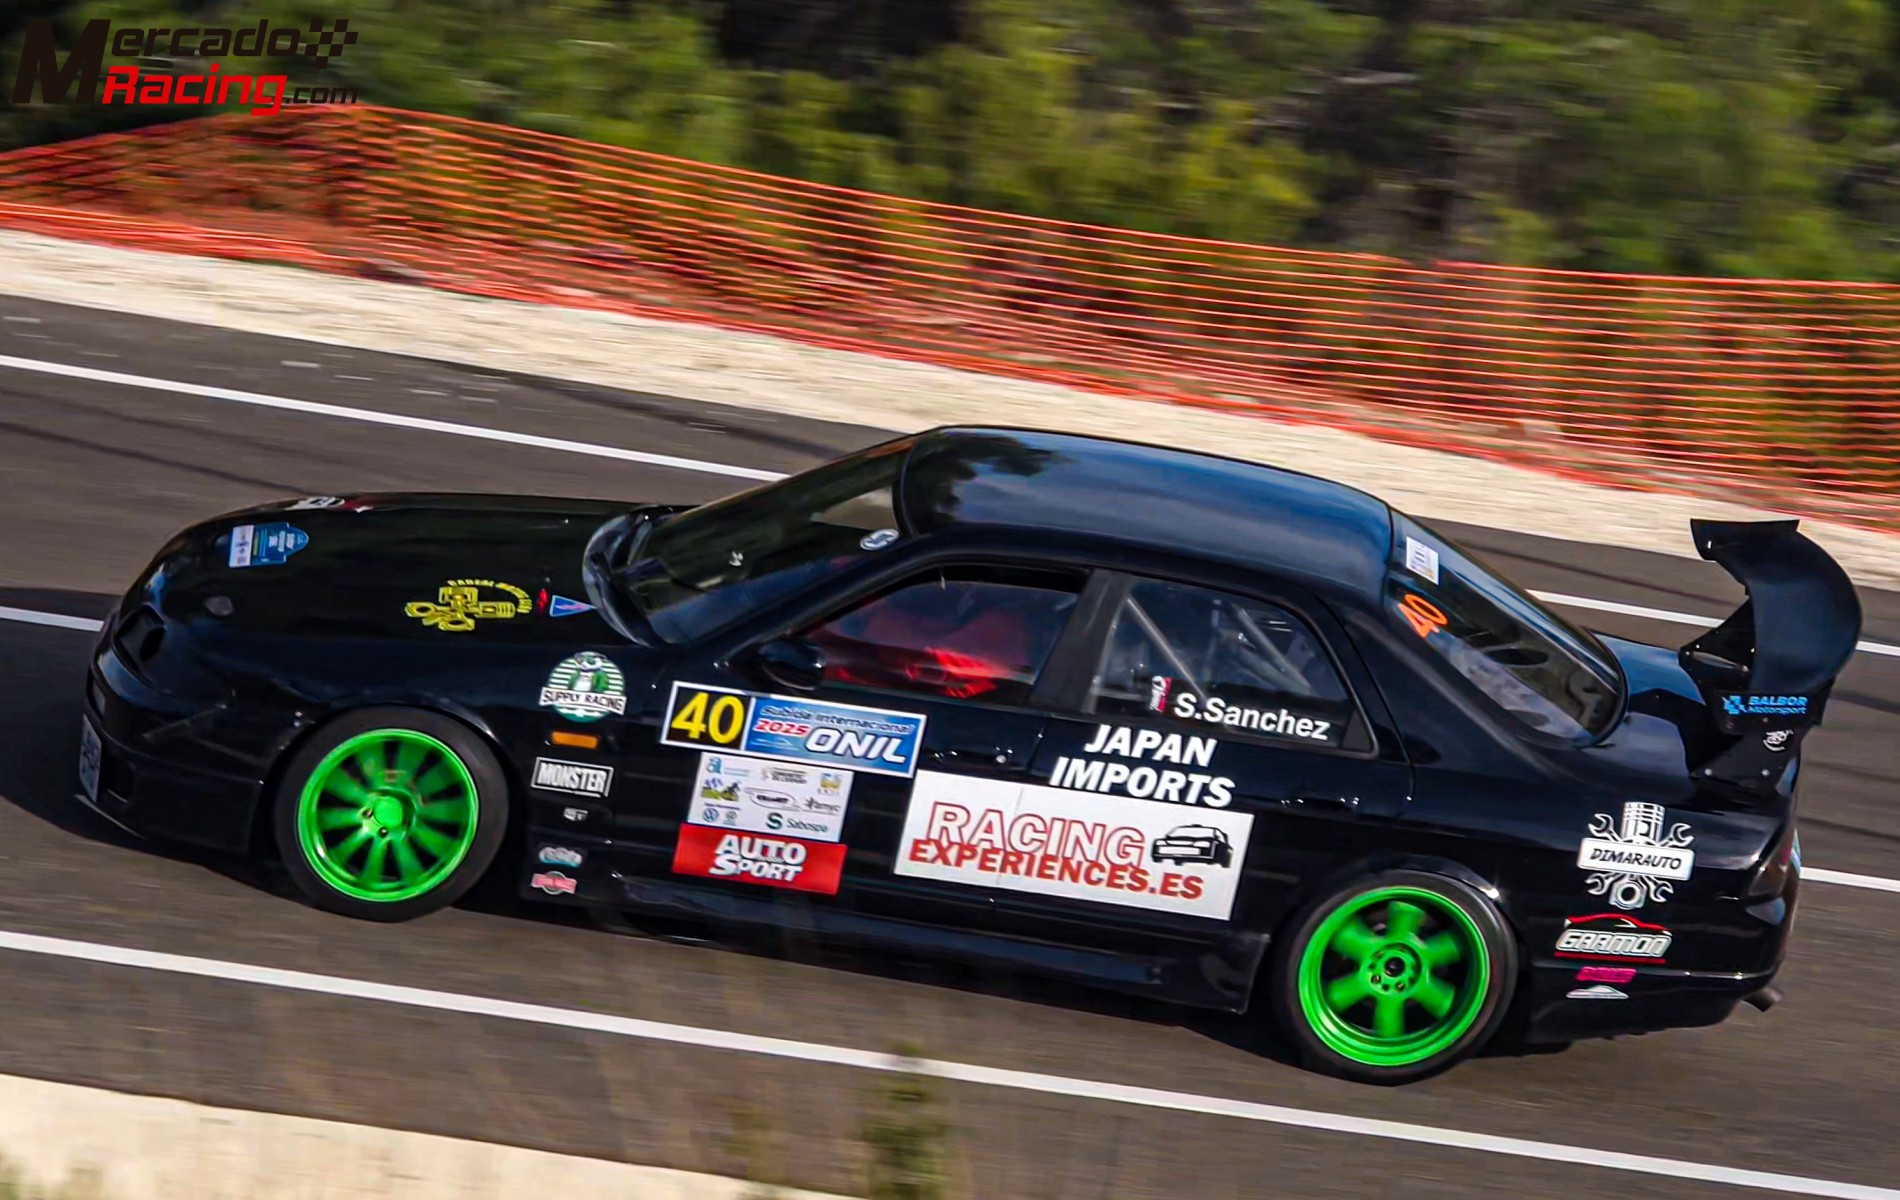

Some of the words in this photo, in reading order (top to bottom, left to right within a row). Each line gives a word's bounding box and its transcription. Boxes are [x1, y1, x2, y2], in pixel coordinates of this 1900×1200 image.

[1398, 594, 1448, 639] 40
[543, 690, 581, 702] SUPPLY
[584, 694, 623, 711] RACING
[671, 692, 744, 744] 40
[1174, 692, 1331, 741] S.Sanchez
[1748, 696, 1808, 706] BALBOR
[753, 719, 811, 737] 2025
[805, 726, 907, 764] ONIL
[1084, 724, 1217, 767] JAPAN
[536, 762, 608, 794] MONSTER
[1049, 757, 1236, 808] IMPORTS
[714, 834, 807, 865] AUTO
[926, 801, 1145, 869] RACING
[908, 838, 1204, 901] EXPERIENCES.ES
[1590, 847, 1682, 871] DIMARAUTO
